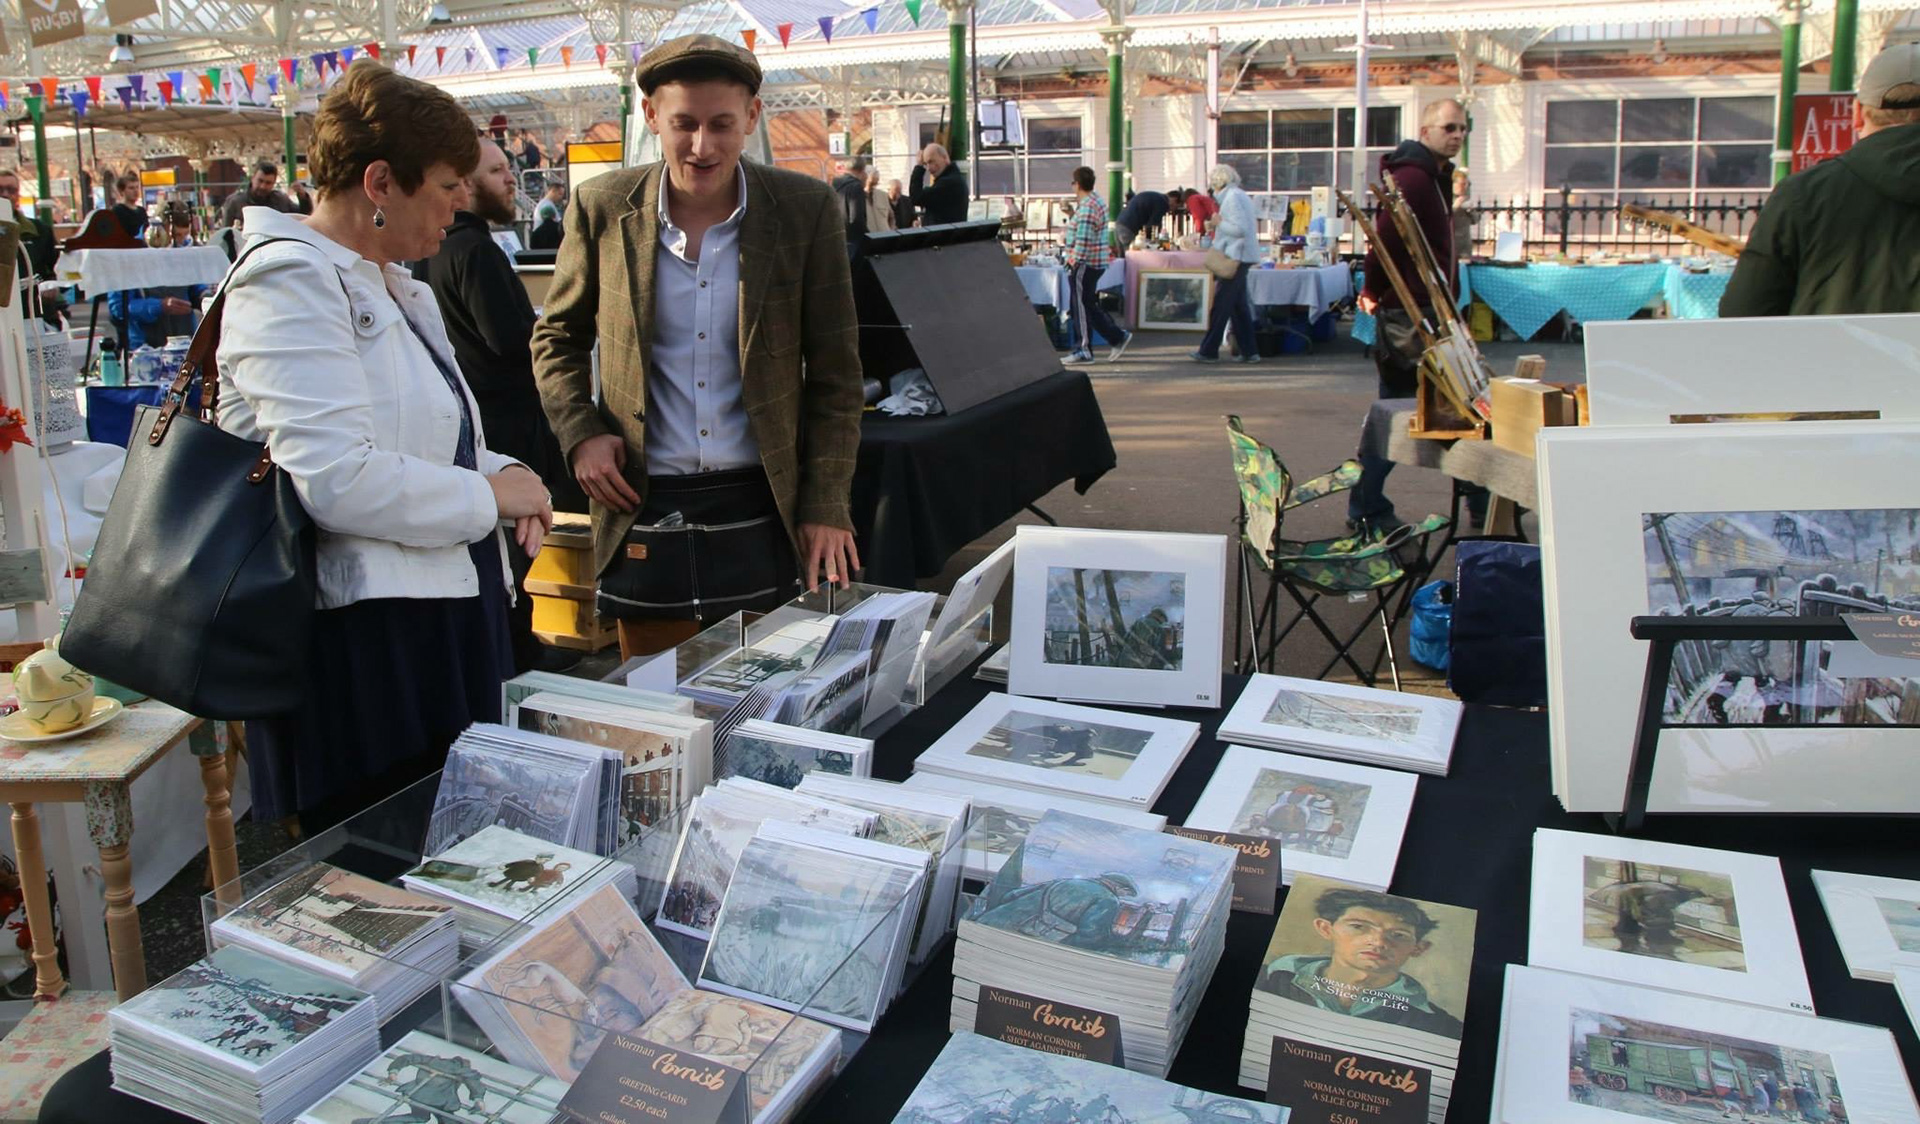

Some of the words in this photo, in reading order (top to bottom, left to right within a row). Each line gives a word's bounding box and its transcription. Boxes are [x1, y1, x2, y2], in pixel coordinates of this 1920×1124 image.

[30, 9, 78, 32] RUGBY
[1830, 96, 1854, 117] TH
[1173, 828, 1208, 840] Norman
[1240, 866, 1265, 875] PRINTS
[989, 990, 1031, 1010] Norman
[1310, 982, 1321, 991] A
[1325, 985, 1358, 1000] Slice
[1361, 996, 1377, 1004] of
[1382, 999, 1410, 1012] Life
[1313, 975, 1360, 992] NORMAN
[1362, 988, 1410, 1003] CORNISH
[613, 1034, 655, 1057] Norman
[1005, 1025, 1044, 1040] NORMAN
[1043, 1034, 1083, 1050] CORNISH:
[1007, 1035, 1028, 1047] SHOT
[1030, 1041, 1064, 1057] AGAINST
[1283, 1042, 1332, 1063] Norman
[618, 1076, 660, 1098] GREETING
[659, 1090, 689, 1106] CARDS
[1303, 1079, 1346, 1096] NORMAN
[1347, 1089, 1392, 1106] CORNISH:
[619, 1094, 646, 1111] £2.50
[645, 1104, 668, 1119] each
[1312, 1092, 1319, 1100] A
[1320, 1094, 1345, 1108] SLICE
[1349, 1100, 1360, 1110] OF
[1361, 1102, 1381, 1115] LIFE
